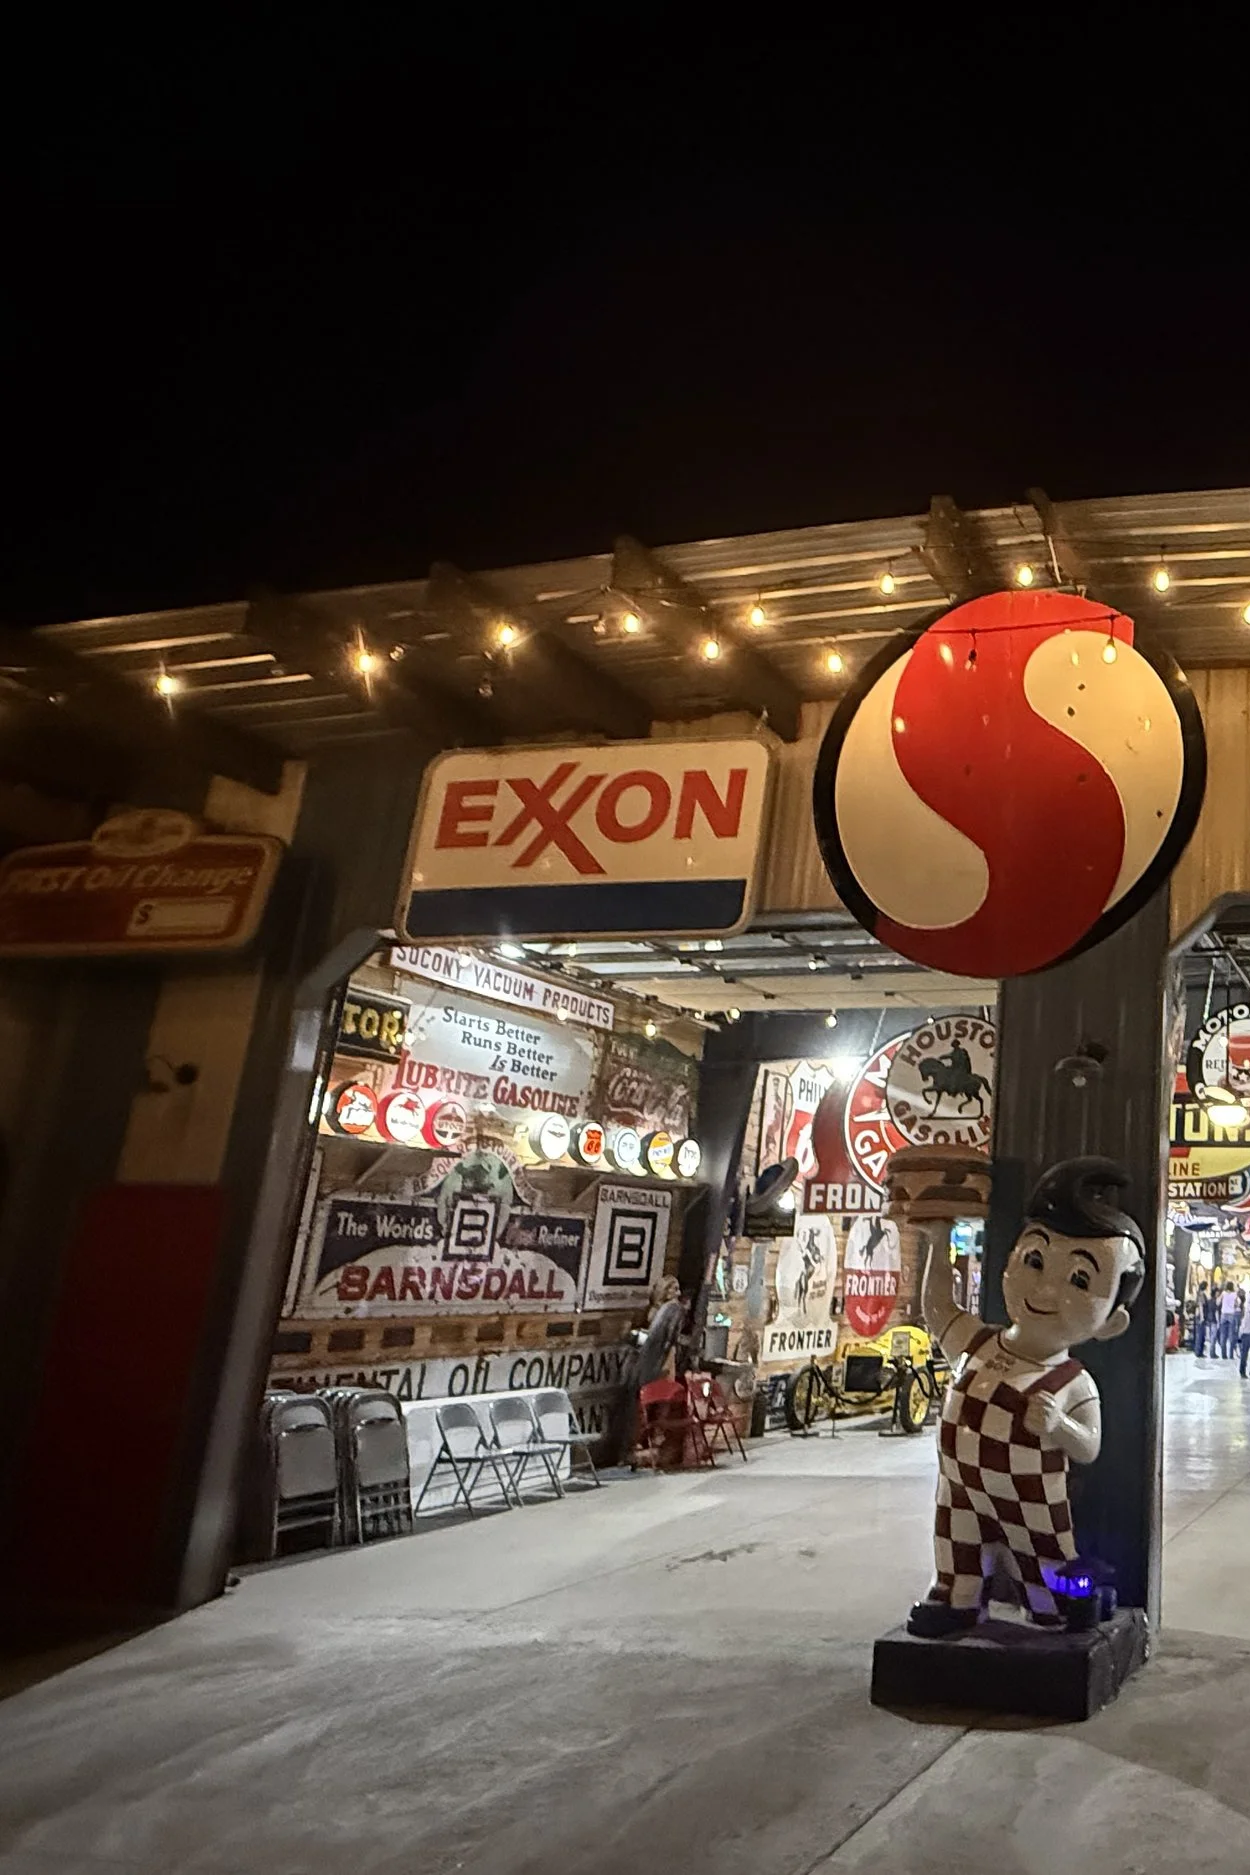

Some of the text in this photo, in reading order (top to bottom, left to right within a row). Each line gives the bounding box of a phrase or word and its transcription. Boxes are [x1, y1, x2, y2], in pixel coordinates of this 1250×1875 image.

[435, 761, 748, 874] EXXON
[397, 947, 611, 1024] SOCONY VACUUM PRODUCTS
[443, 1007, 540, 1045] Starts Better
[901, 1018, 997, 1067] HOUSTO
[462, 1031, 553, 1065] Runs Better
[392, 1048, 580, 1119] LUBRITE GASOLINE
[489, 1054, 557, 1083] Is Better
[1170, 1163, 1200, 1176] INE
[600, 1187, 669, 1207] BARNSDALL
[809, 1184, 881, 1210] FRON
[1168, 1182, 1227, 1197] STATION
[337, 1213, 367, 1236] The
[376, 1215, 433, 1240] World's
[538, 1224, 580, 1247] Refiner
[337, 1265, 565, 1301] BARNSDALL
[846, 1272, 897, 1297] FRONTIER
[769, 1329, 833, 1353] FRONTIER
[450, 1355, 492, 1397] OIL
[509, 1350, 626, 1391] COMPANY
